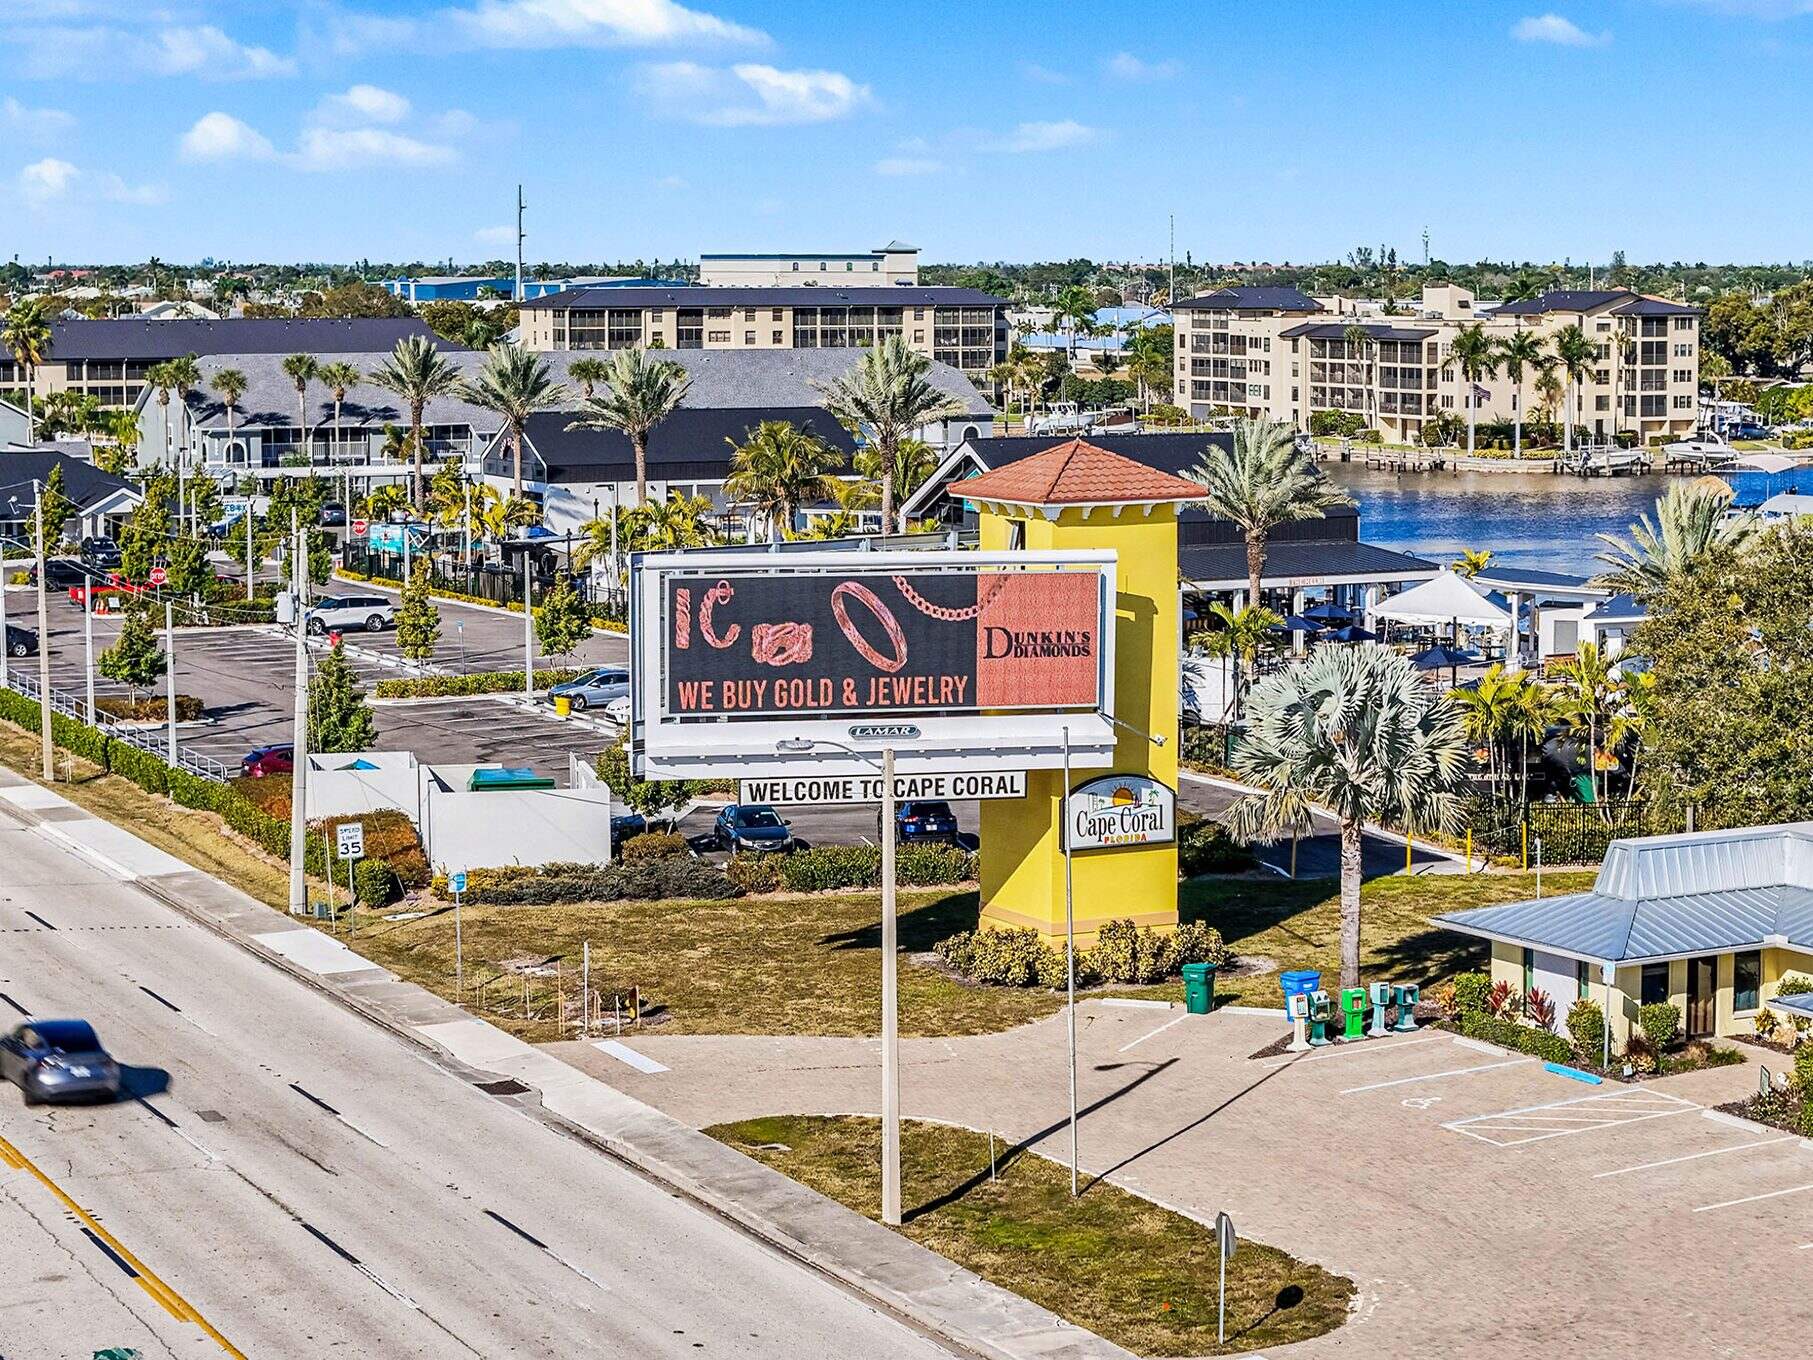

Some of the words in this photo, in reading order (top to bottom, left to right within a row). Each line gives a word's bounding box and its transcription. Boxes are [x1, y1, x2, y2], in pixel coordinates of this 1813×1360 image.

[983, 627, 1091, 659] DUNKIN'S
[1013, 644, 1091, 658] DIAMONDS
[678, 681, 714, 709] WE
[722, 679, 768, 709] BUY
[774, 678, 834, 708] GOLD
[842, 677, 859, 707] &
[865, 675, 968, 707] JEWELRY
[856, 727, 911, 736] LAMAR
[748, 780, 853, 802] WELCOME
[893, 776, 946, 798] CAPE
[952, 774, 1020, 796] CORAL
[1076, 810, 1117, 843] Cape
[1120, 804, 1165, 834] Coral
[340, 841, 361, 855] 35
[1104, 833, 1149, 844] FLORIDA
